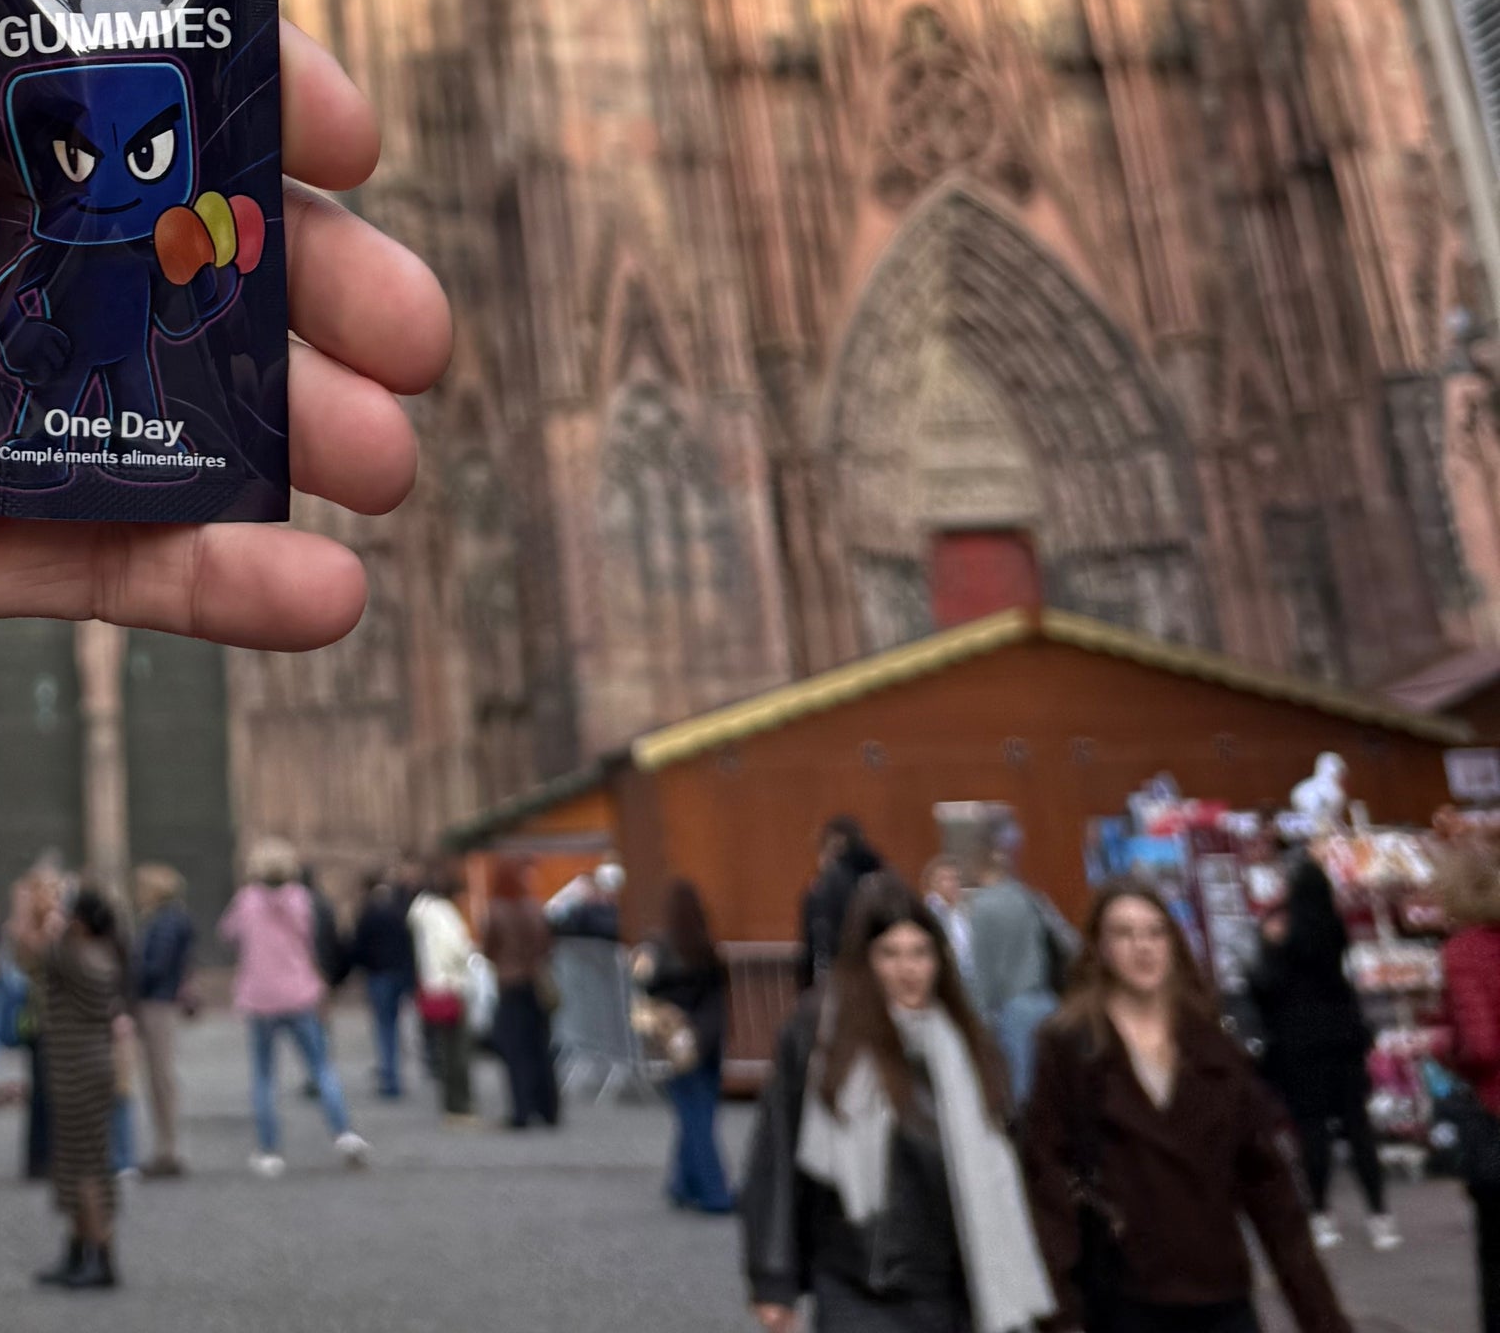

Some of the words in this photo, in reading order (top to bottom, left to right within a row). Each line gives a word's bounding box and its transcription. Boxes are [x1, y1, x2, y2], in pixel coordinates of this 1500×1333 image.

[44, 408, 112, 438] One
[120, 411, 184, 446] Day
[0, 445, 119, 465] Compléments
[122, 450, 226, 468] alimentaires
